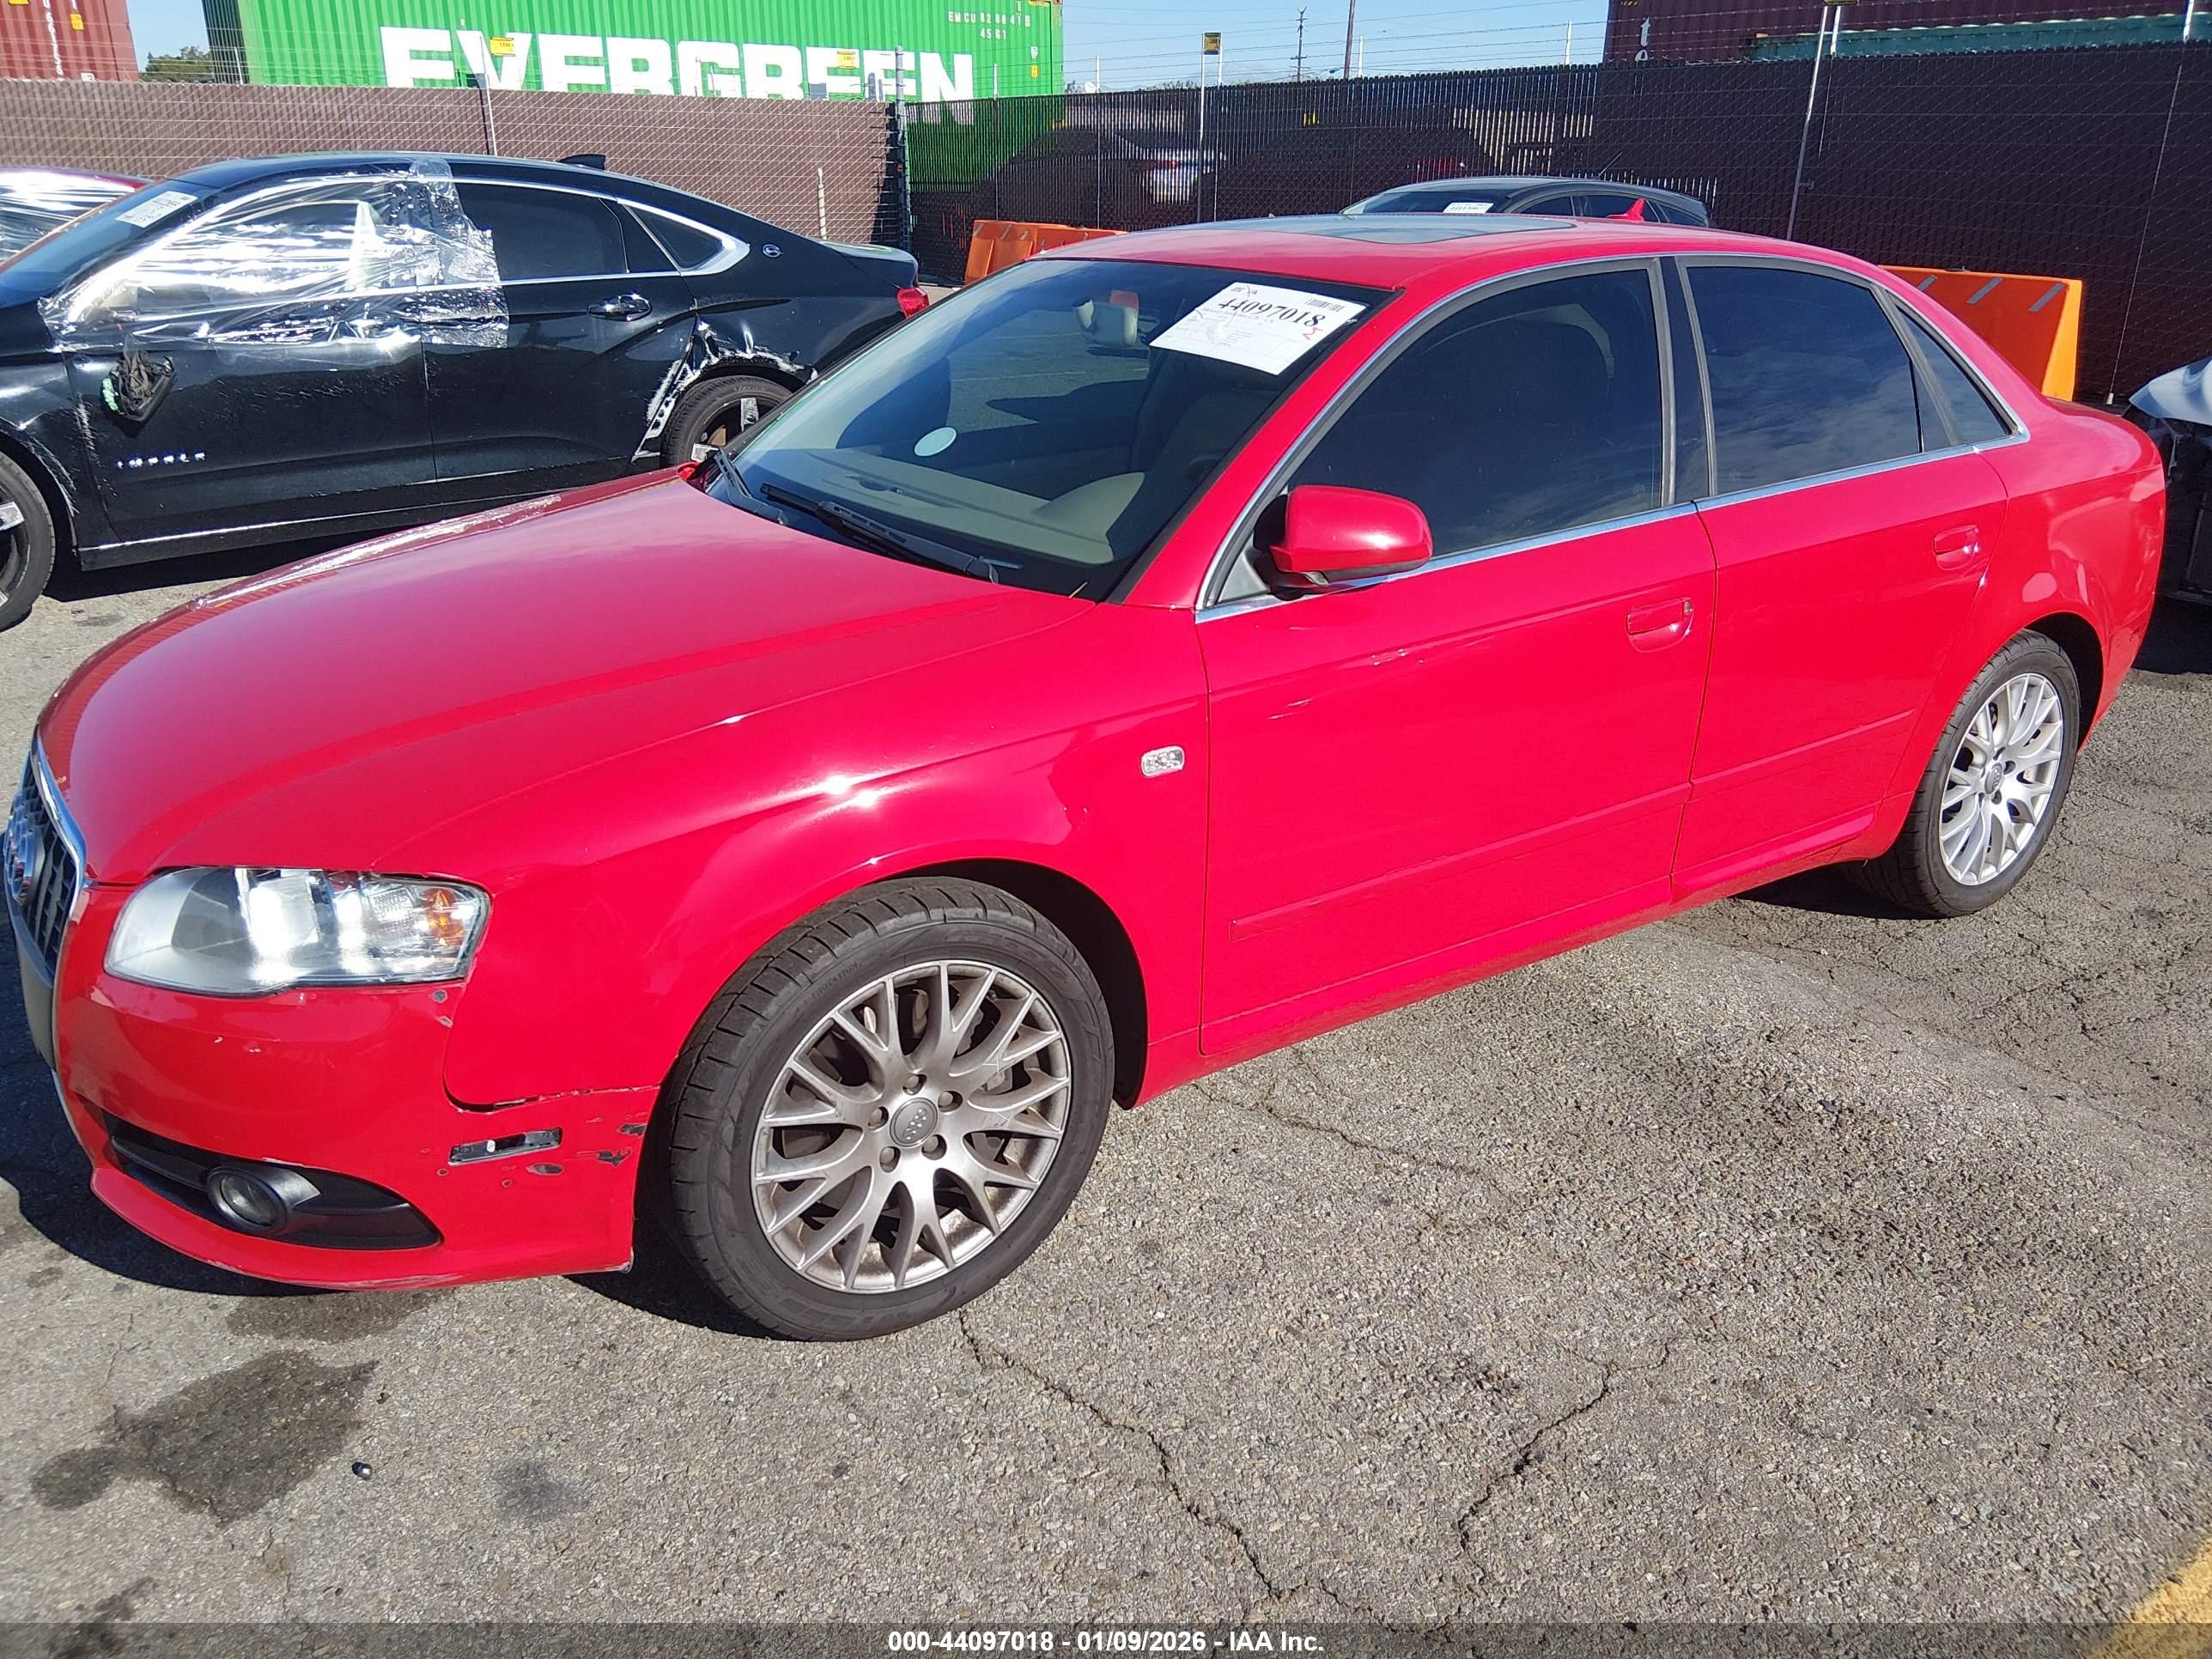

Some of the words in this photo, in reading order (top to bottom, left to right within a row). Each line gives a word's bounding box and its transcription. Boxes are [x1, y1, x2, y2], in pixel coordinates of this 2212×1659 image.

[948, 10, 976, 24] EMCU
[380, 26, 974, 103] EVERGREEN
[1218, 298, 1326, 327] 44097018
